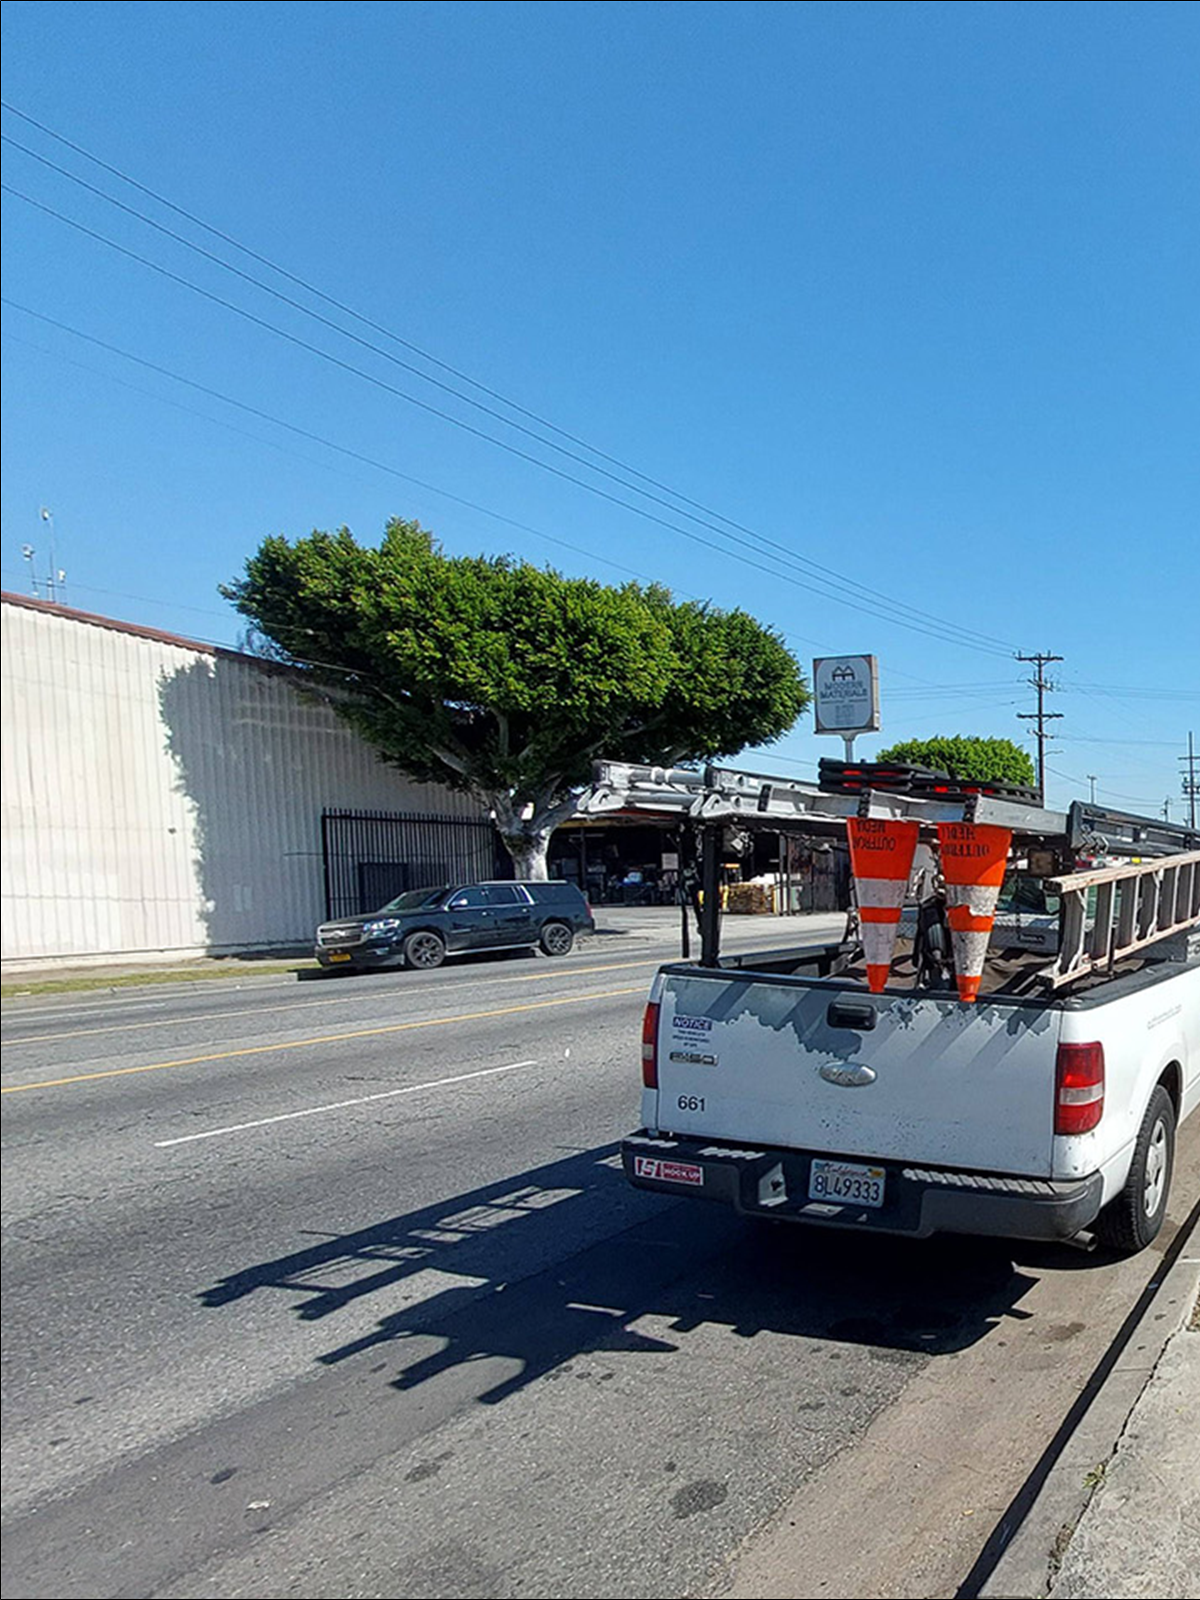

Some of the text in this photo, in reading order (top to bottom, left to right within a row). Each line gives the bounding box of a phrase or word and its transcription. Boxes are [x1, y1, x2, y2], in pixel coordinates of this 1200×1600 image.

[675, 1018, 708, 1030] NOTICE
[677, 1095, 706, 1112] 661
[814, 1174, 880, 1202] 8L49333
